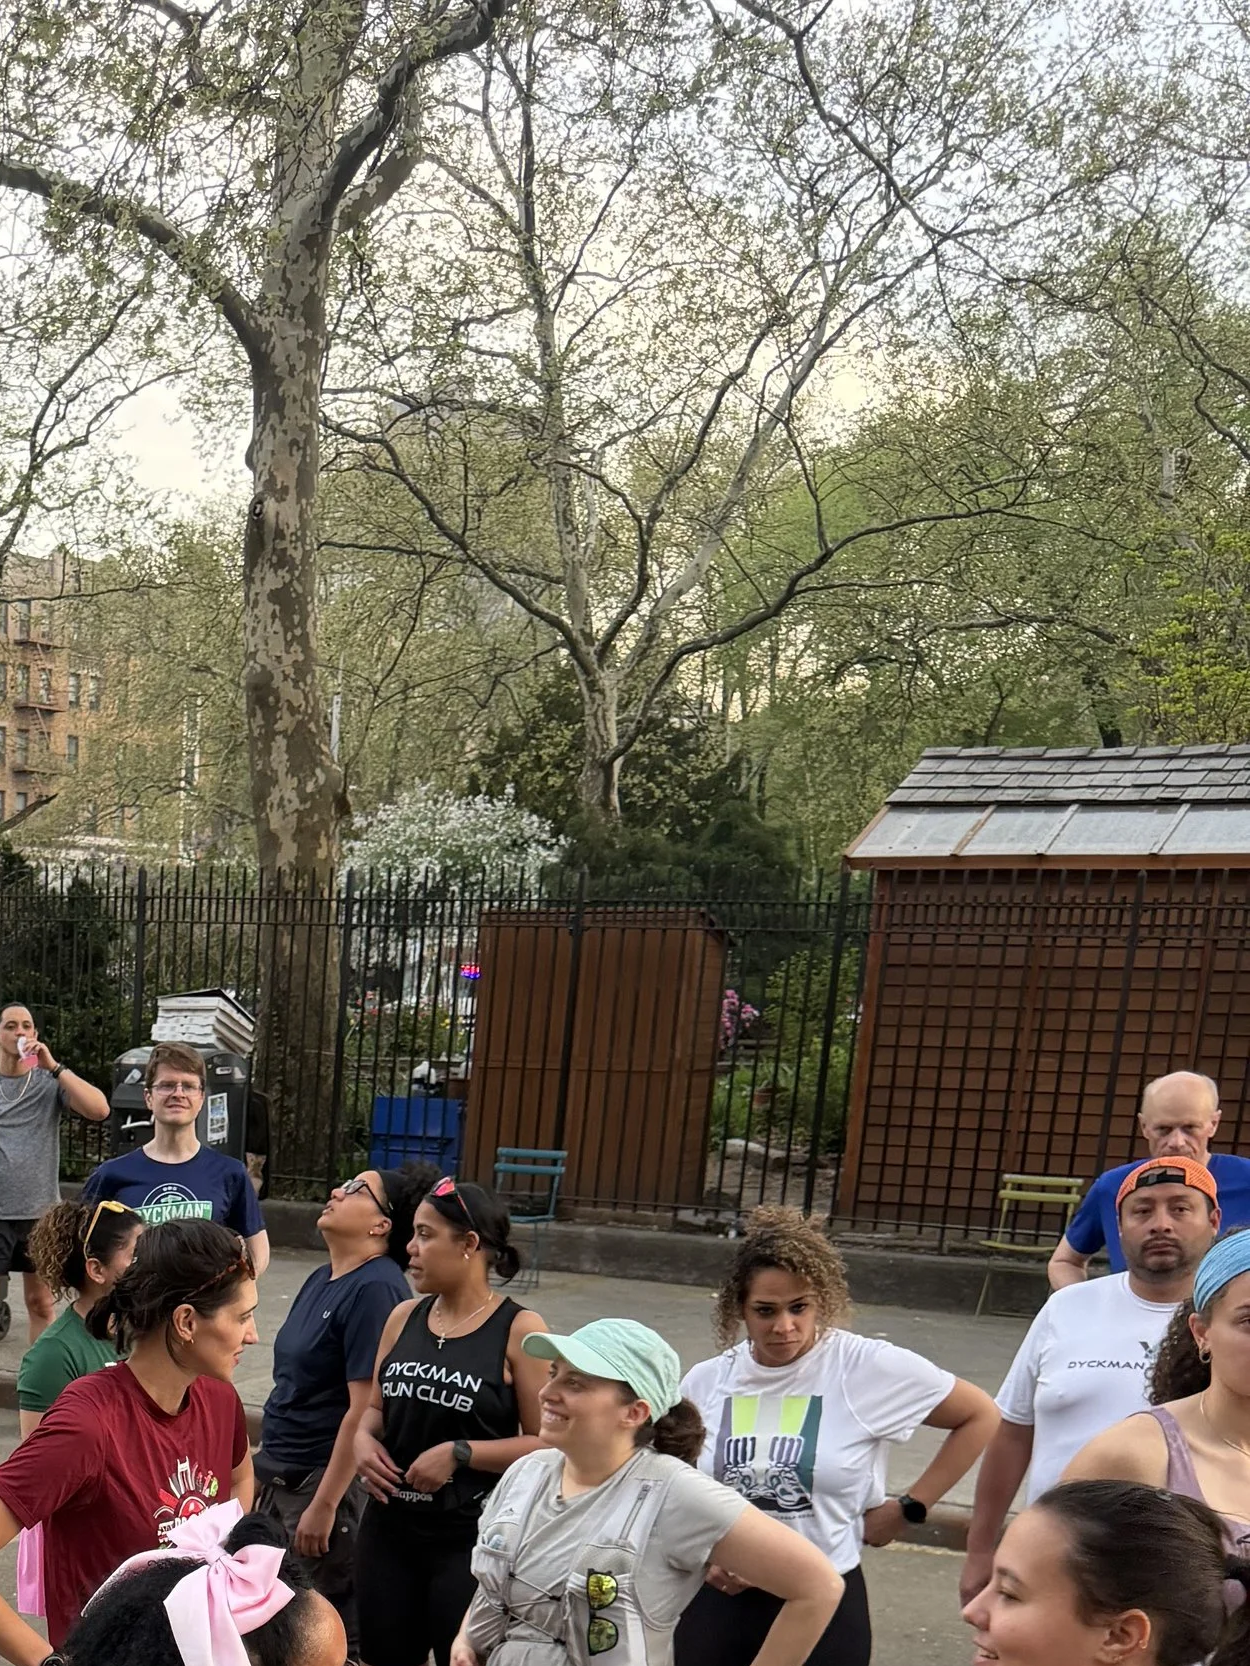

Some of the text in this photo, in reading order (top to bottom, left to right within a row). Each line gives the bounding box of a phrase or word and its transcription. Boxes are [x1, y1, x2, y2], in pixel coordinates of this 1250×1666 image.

[385, 1362, 483, 1393] DYCKMAN
[1067, 1360, 1146, 1370] DYCKMAN
[382, 1381, 474, 1413] RUN CLUB
